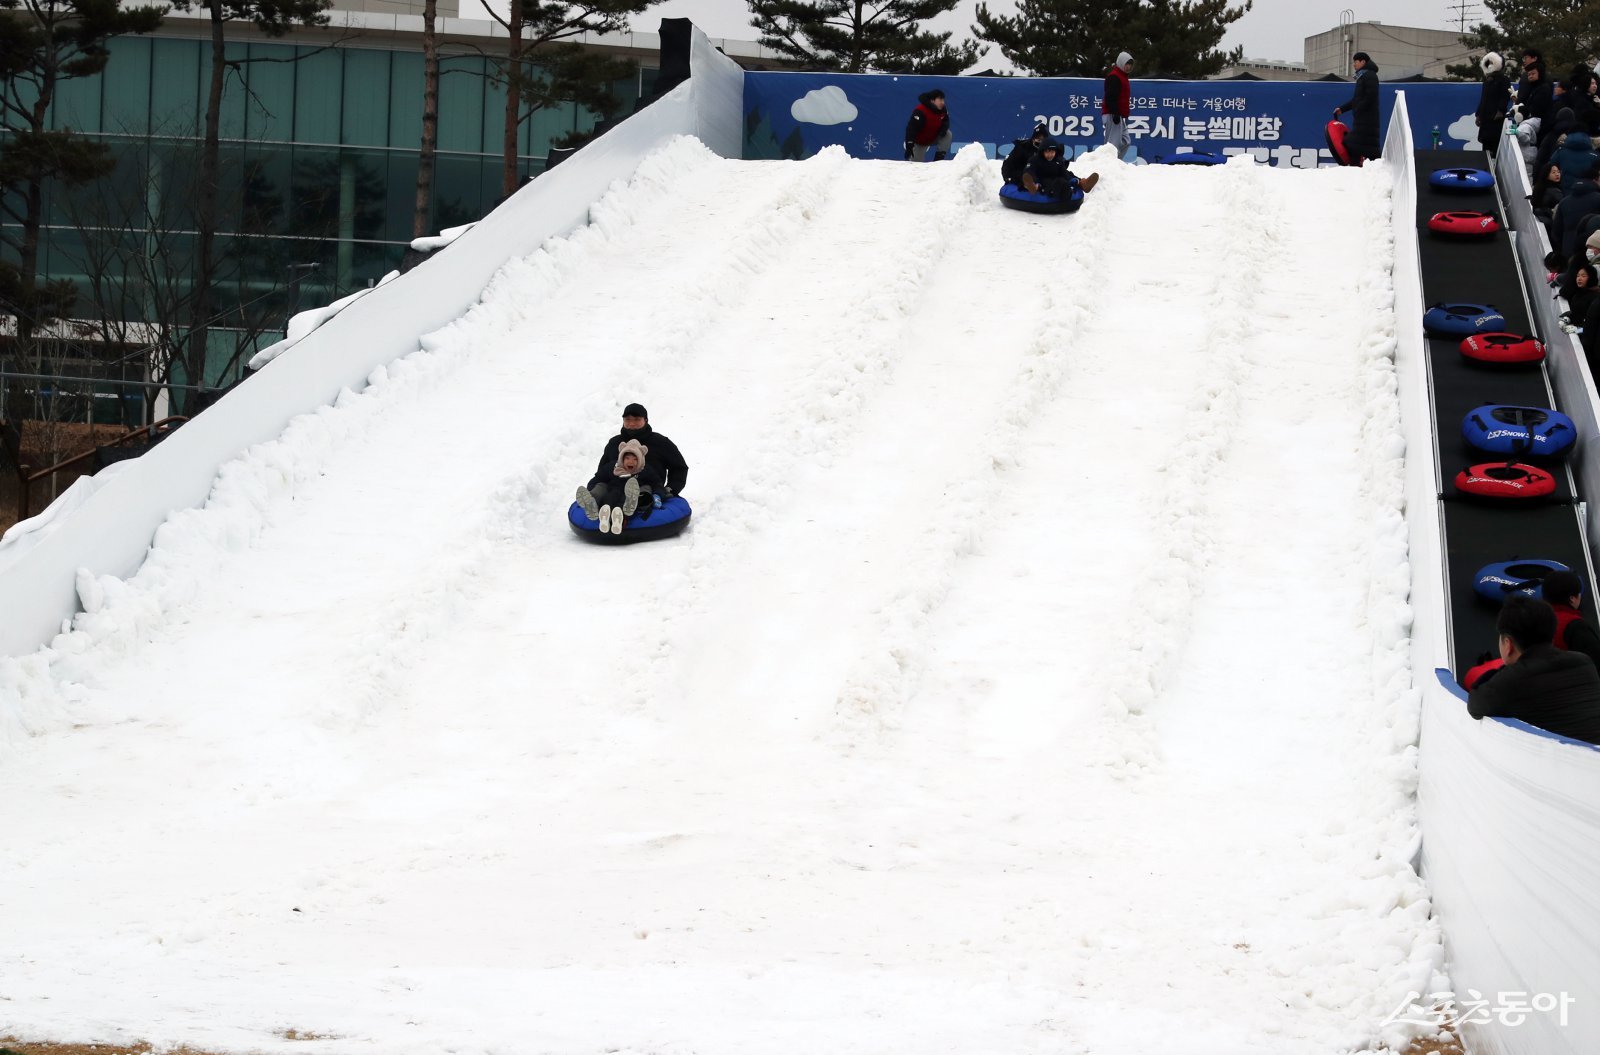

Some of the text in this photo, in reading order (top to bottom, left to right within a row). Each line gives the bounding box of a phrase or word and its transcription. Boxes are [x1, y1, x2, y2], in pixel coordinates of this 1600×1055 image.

[1069, 94, 1246, 111] 청주 눈장으로 떠나는 겨울여행
[1102, 115, 1175, 140] 주시
[1182, 116, 1283, 141] 눈썰매장
